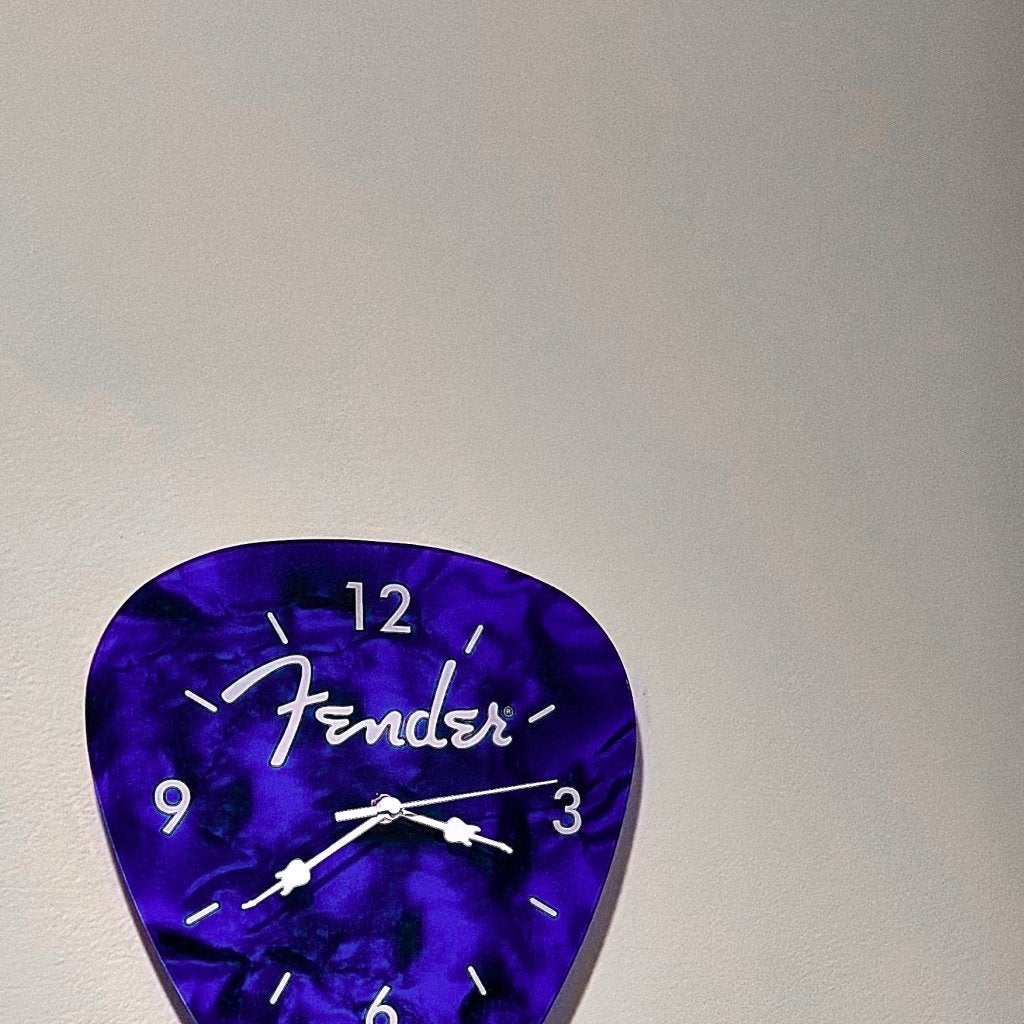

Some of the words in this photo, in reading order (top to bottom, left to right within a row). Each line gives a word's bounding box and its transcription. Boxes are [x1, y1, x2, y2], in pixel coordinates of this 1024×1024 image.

[346, 581, 412, 634] 12
[221, 654, 513, 768] Fender
[154, 779, 191, 835] 9
[552, 787, 582, 835] 3
